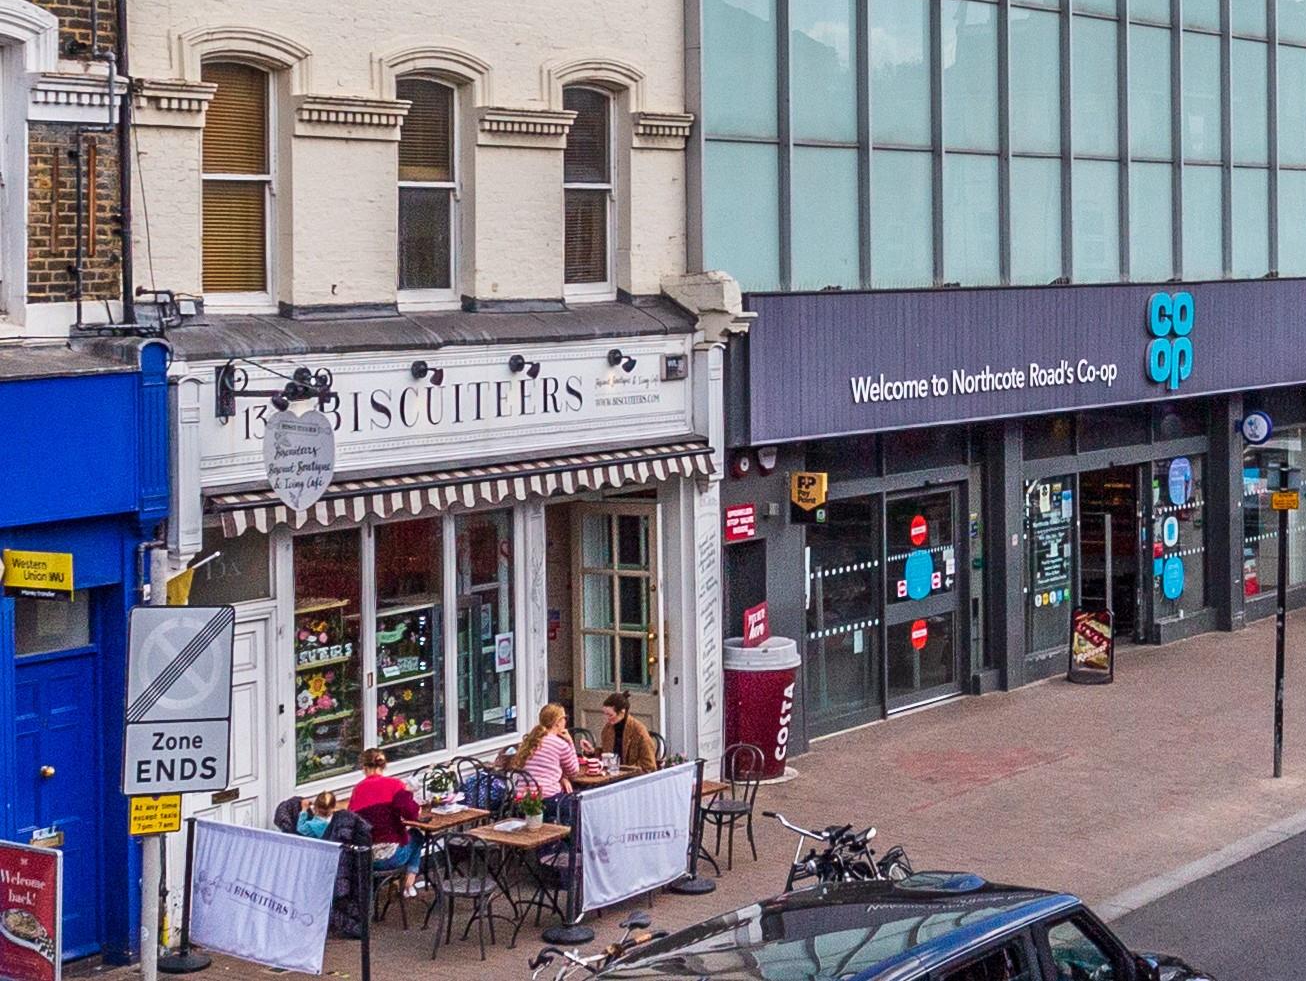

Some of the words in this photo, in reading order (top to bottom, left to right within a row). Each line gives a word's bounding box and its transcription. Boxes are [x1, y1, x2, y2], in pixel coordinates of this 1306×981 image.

[851, 373, 928, 404] Welcome
[931, 375, 949, 398] to
[952, 365, 1025, 396] Northcote
[1029, 360, 1074, 388] Road's
[1077, 358, 1118, 387] Co-op
[319, 375, 584, 433] BISCUITEERS
[12, 557, 47, 570] Western
[24, 570, 47, 581] Union
[774, 682, 796, 762] COSTA
[152, 732, 203, 750] Zone
[136, 756, 217, 783] ENDS
[146, 804, 159, 812] any
[133, 814, 158, 822] except
[0, 868, 46, 890] Welcome
[8, 889, 36, 906] back!
